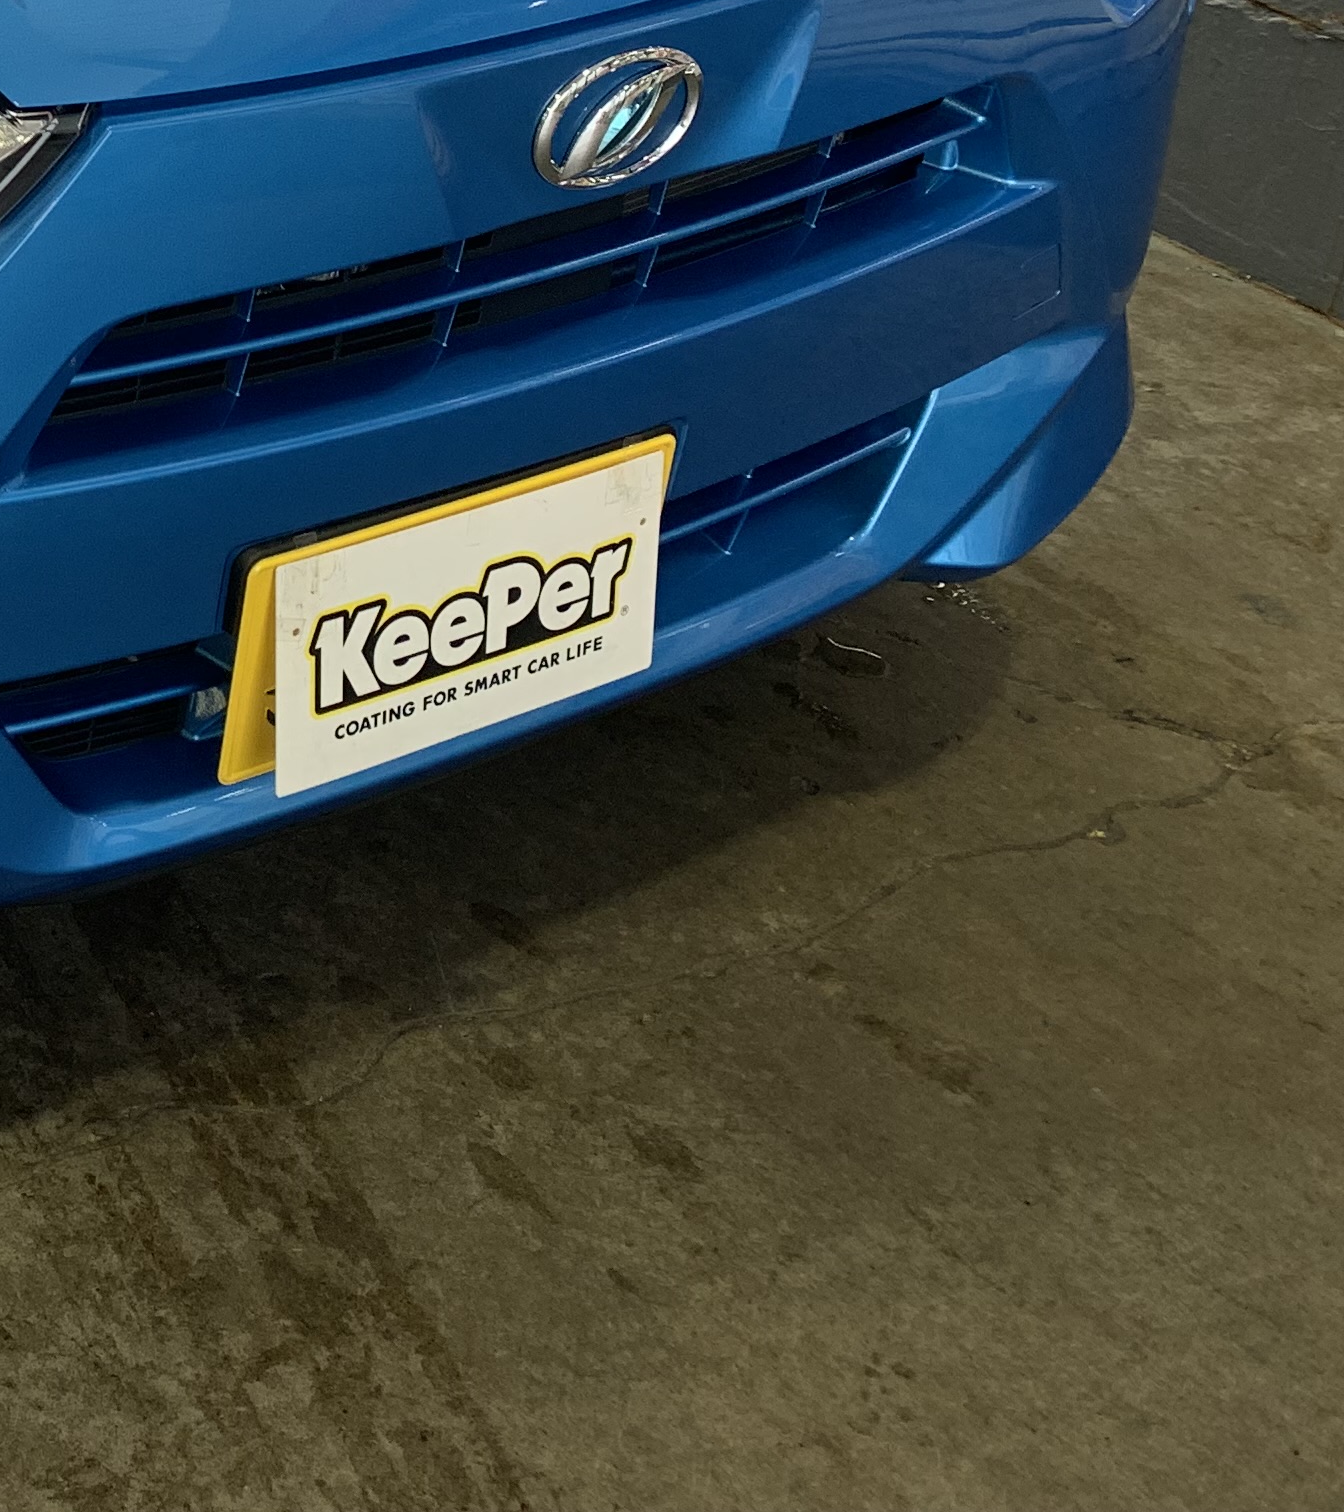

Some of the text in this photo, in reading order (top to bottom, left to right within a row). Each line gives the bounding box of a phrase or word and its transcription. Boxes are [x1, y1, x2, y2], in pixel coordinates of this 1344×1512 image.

[308, 536, 633, 716] KeePer
[333, 636, 604, 740] COATING FOR SMART CAR LIFE
